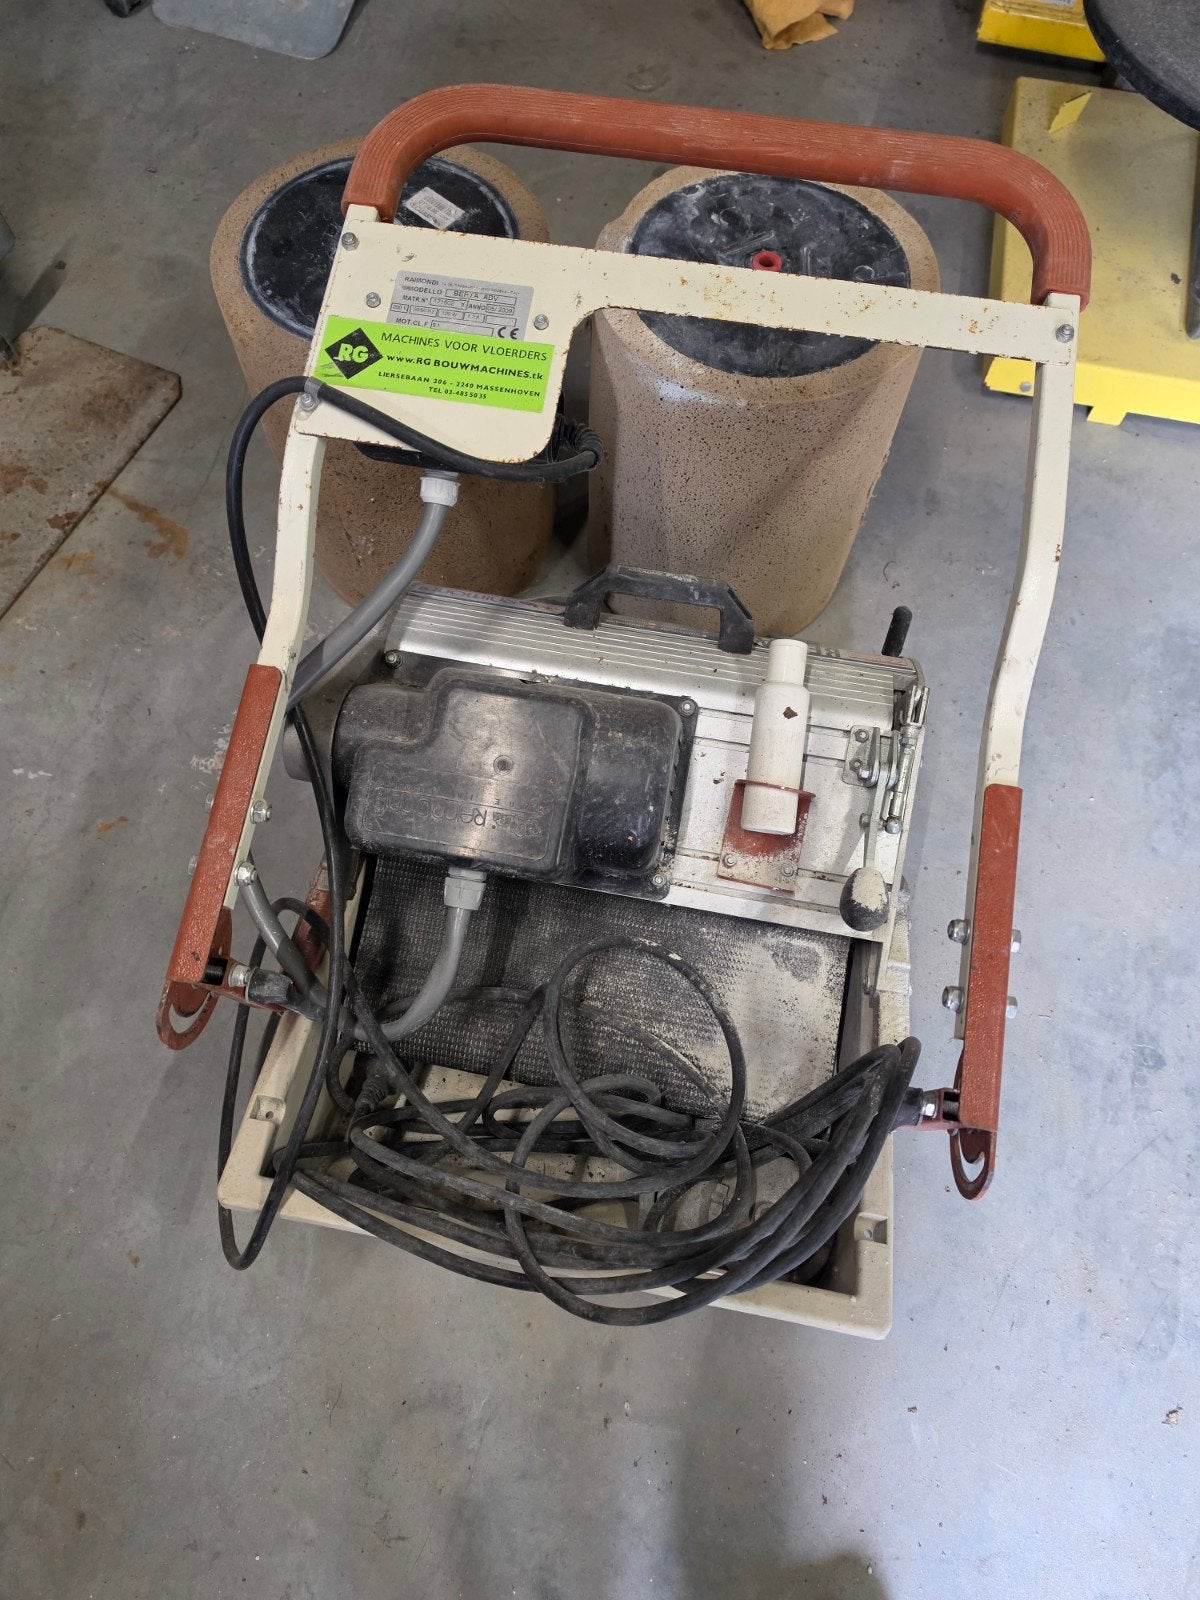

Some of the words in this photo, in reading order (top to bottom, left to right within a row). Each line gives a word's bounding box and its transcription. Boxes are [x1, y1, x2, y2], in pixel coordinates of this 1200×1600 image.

[404, 276, 439, 286] RAIMONDI
[406, 286, 443, 296] MODELLO
[483, 294, 499, 302] ADV
[334, 343, 369, 363] RG
[381, 332, 440, 348] MACHINES
[444, 340, 478, 353] VOOR
[482, 345, 548, 362] VLOERDERS
[378, 371, 430, 383] LIERSEBAAN
[433, 378, 447, 386] 206
[456, 381, 474, 389] 2240
[476, 384, 541, 398] MASSENHOVEN
[428, 386, 443, 395] TEL
